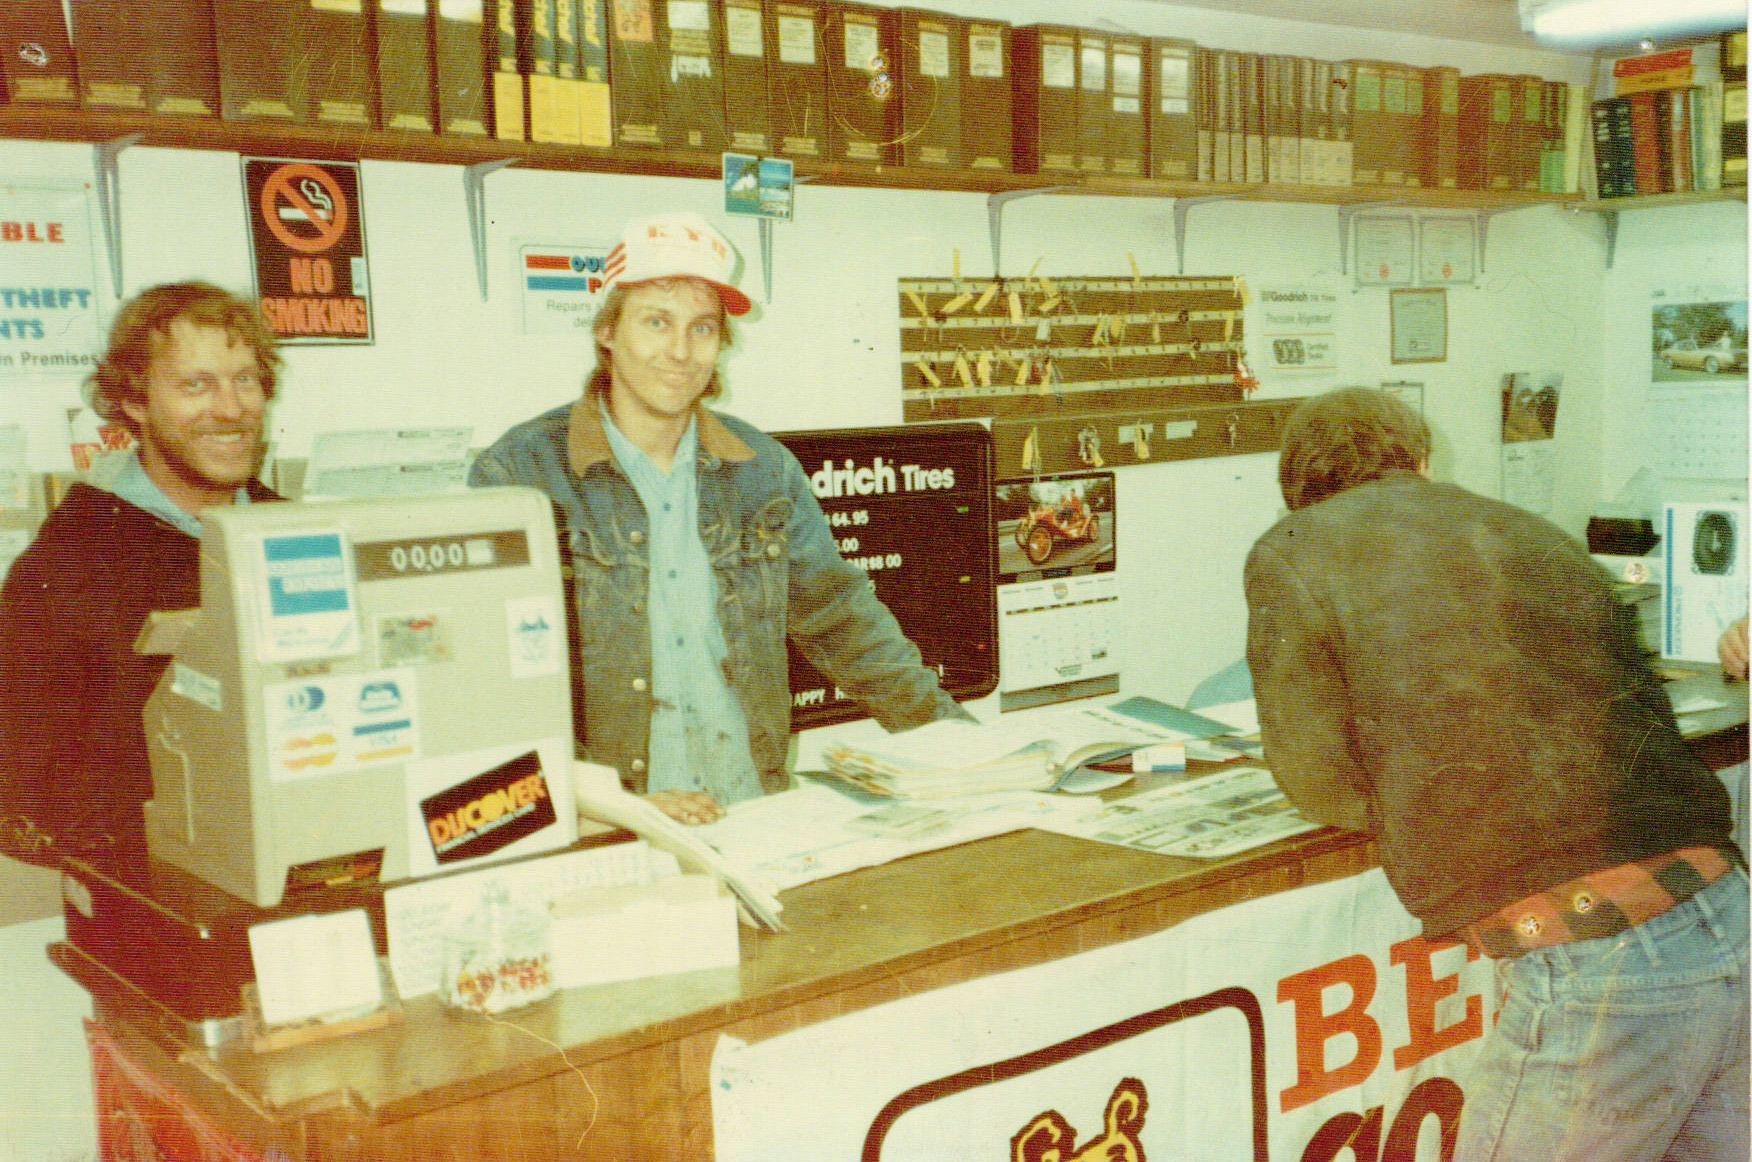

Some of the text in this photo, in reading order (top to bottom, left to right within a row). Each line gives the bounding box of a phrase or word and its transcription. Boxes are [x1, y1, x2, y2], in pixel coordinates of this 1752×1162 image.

[0, 221, 65, 244] BLE
[290, 256, 336, 293] NO
[0, 287, 91, 309] THEFT
[546, 299, 592, 313] Repairs
[260, 298, 368, 335] SMOKING
[20, 351, 99, 368] Premises
[901, 464, 956, 491] Tires
[1276, 934, 1509, 1114] BE
